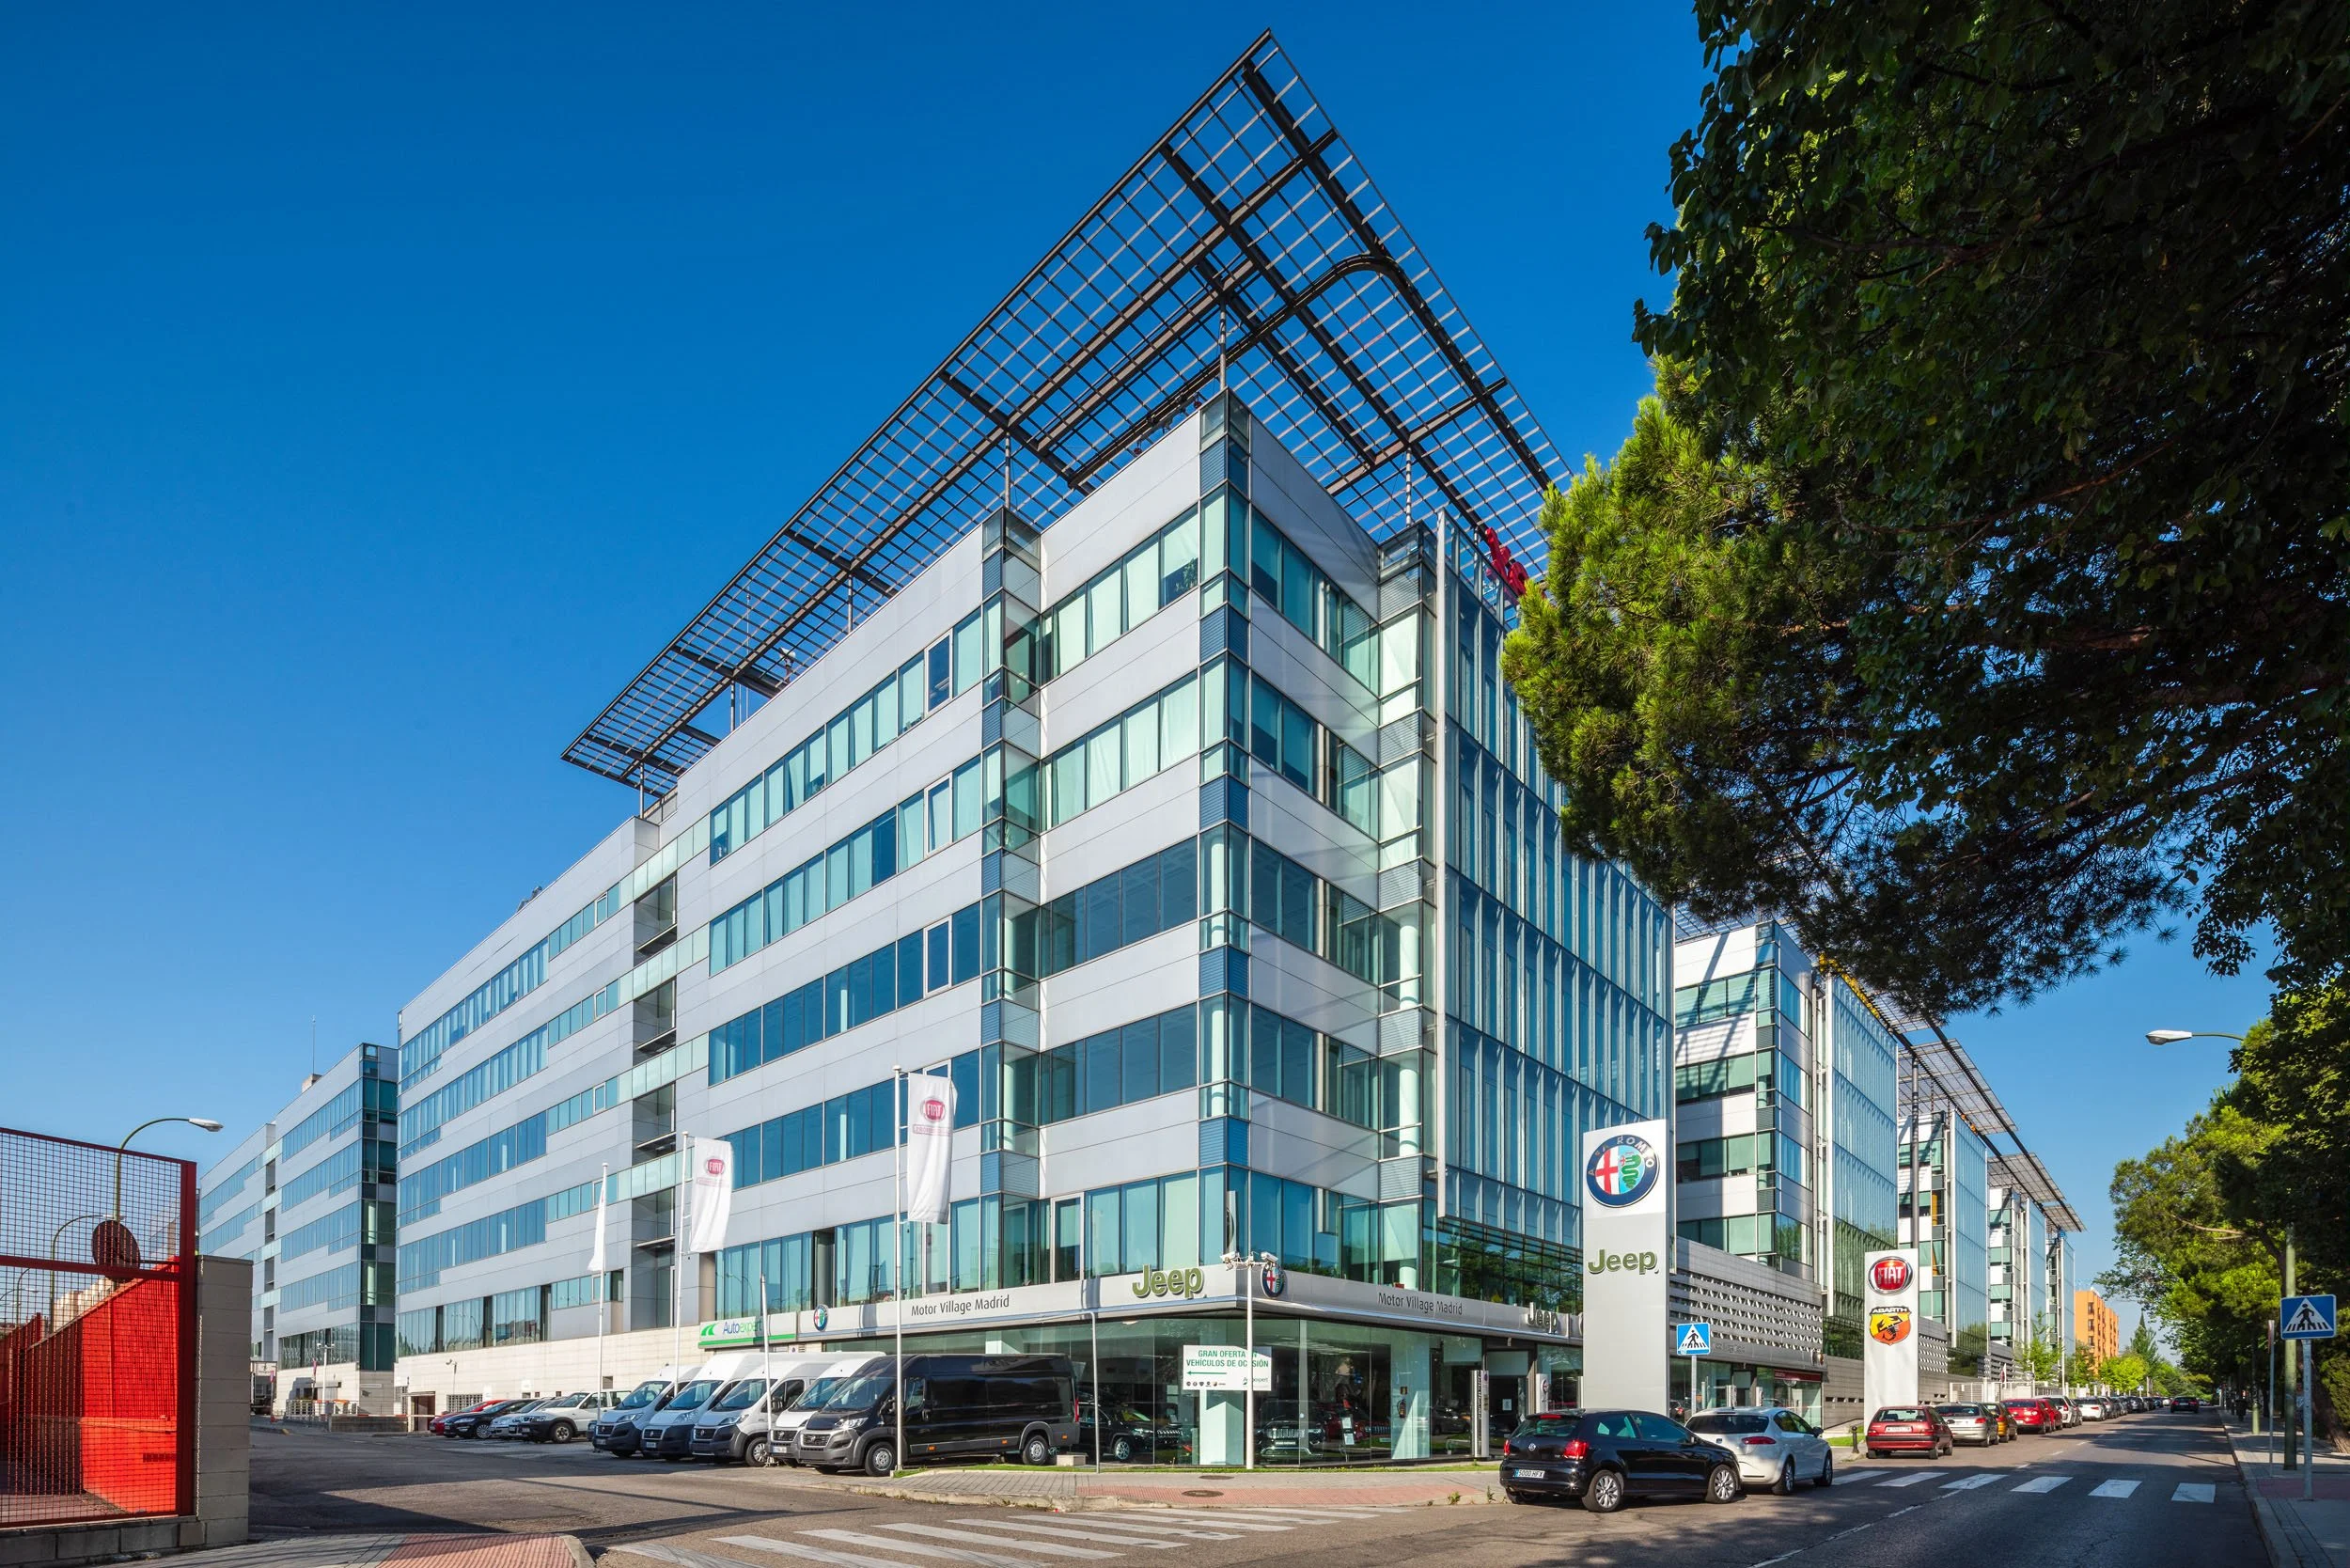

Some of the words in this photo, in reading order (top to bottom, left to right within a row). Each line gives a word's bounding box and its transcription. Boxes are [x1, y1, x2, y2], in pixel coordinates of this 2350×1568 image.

[927, 1104, 942, 1116] FIAT
[1617, 1135, 1654, 1168] ROMO
[709, 1161, 723, 1172] FIAT
[1588, 1248, 1657, 1275] Jeep
[1132, 1263, 1204, 1300] Jeep
[1877, 1266, 1904, 1284] FIAT
[911, 1305, 937, 1316] Motor
[940, 1300, 972, 1314] Village
[975, 1294, 1010, 1310] Madrid
[1378, 1293, 1404, 1307] Motor
[1406, 1295, 1434, 1313] Village
[1436, 1300, 1463, 1315] Madrid
[1528, 1302, 1558, 1333] Jeep
[1238, 1359, 1269, 1368] OCSIÓN
